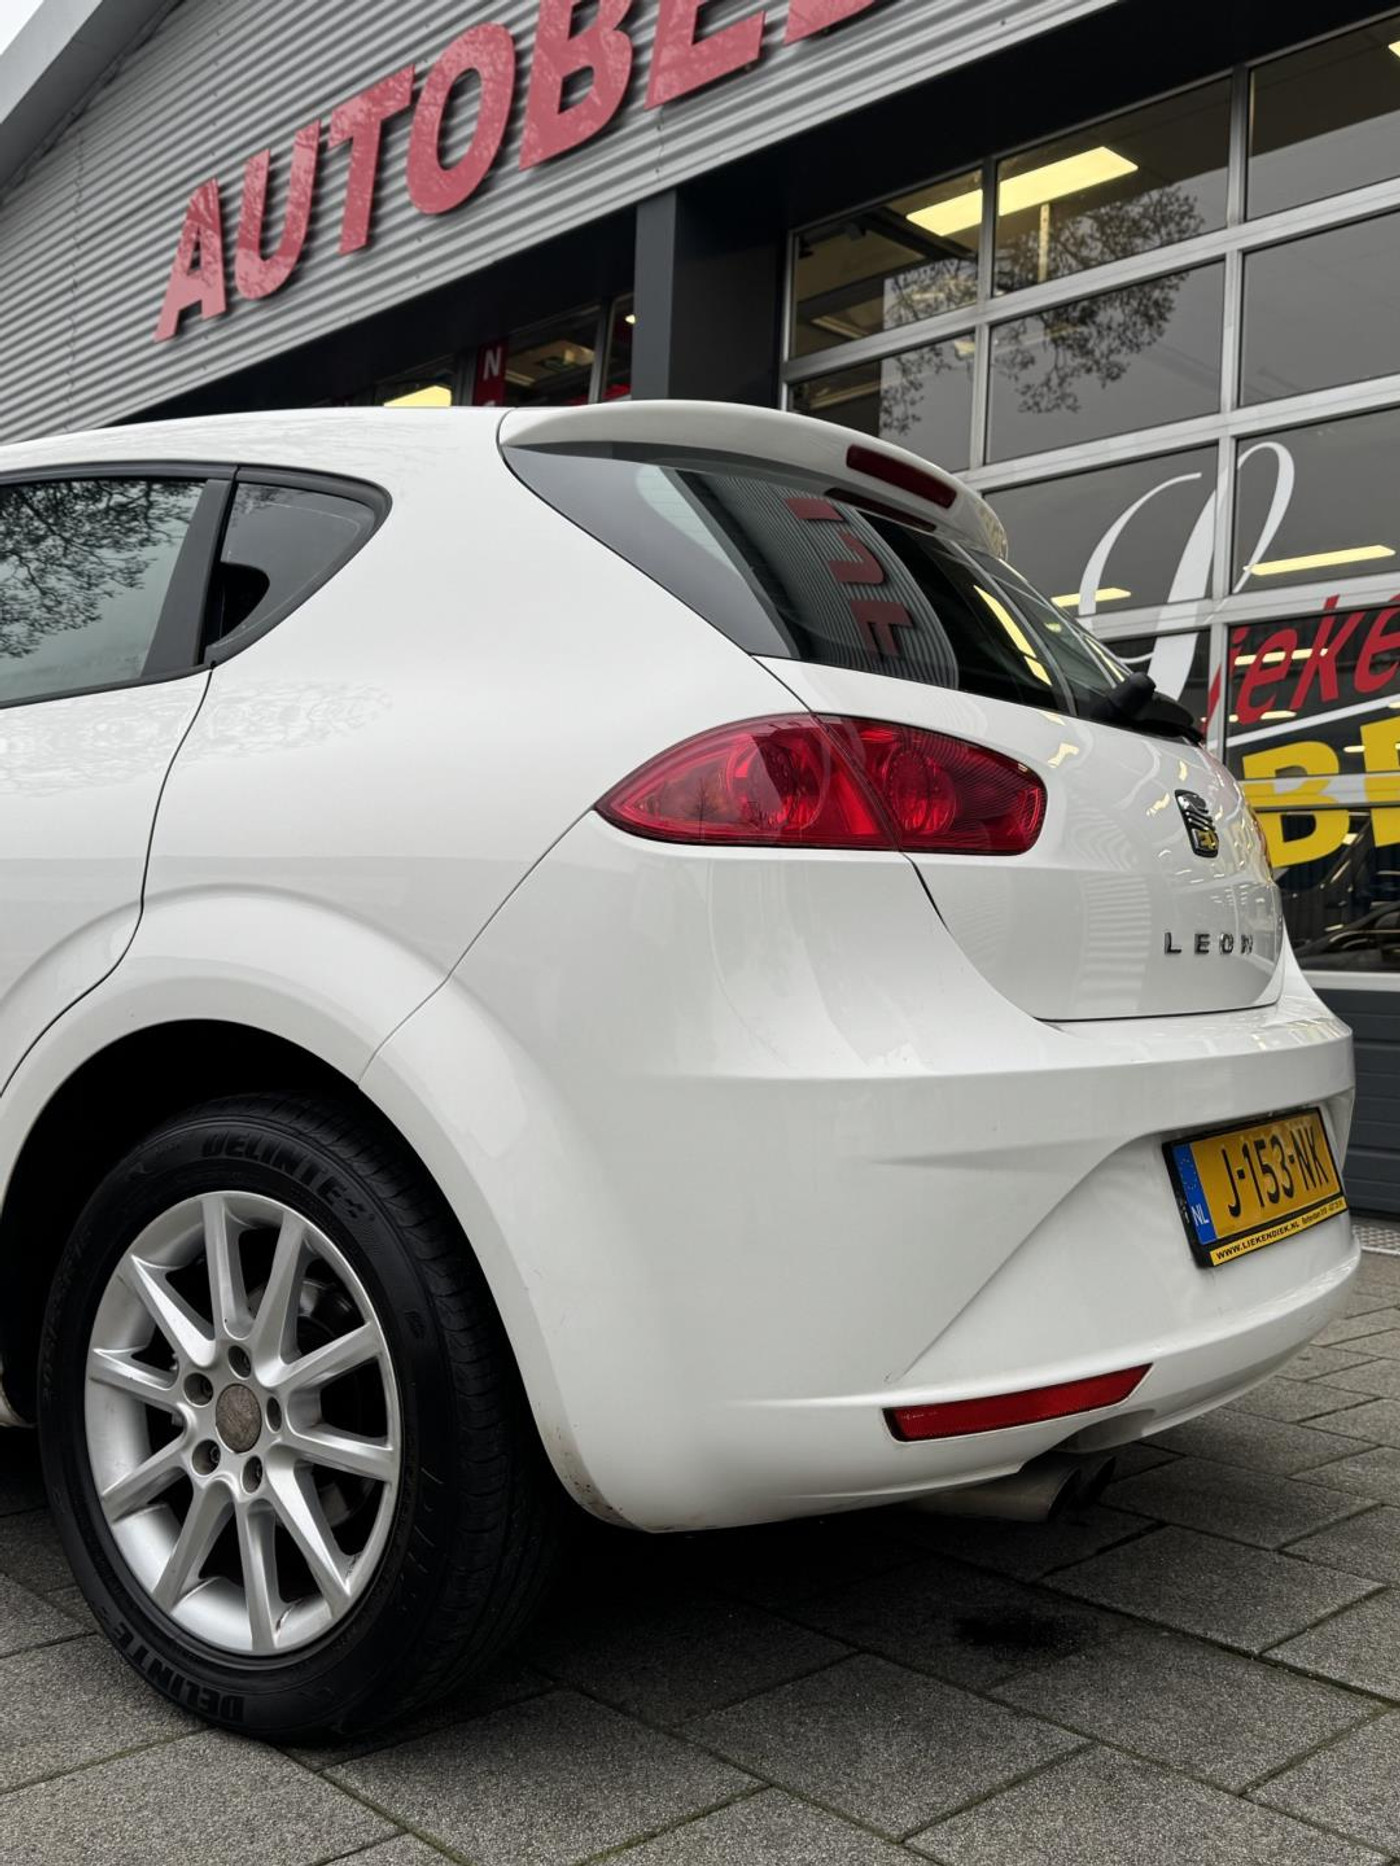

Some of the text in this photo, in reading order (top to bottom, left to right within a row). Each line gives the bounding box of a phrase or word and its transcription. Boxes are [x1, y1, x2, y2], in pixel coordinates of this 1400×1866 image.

[154, 0, 875, 344] AUTOBE
[1164, 931, 1254, 955] LEON
[1219, 1124, 1329, 1218] J-153-NK
[1191, 1204, 1210, 1228] NL
